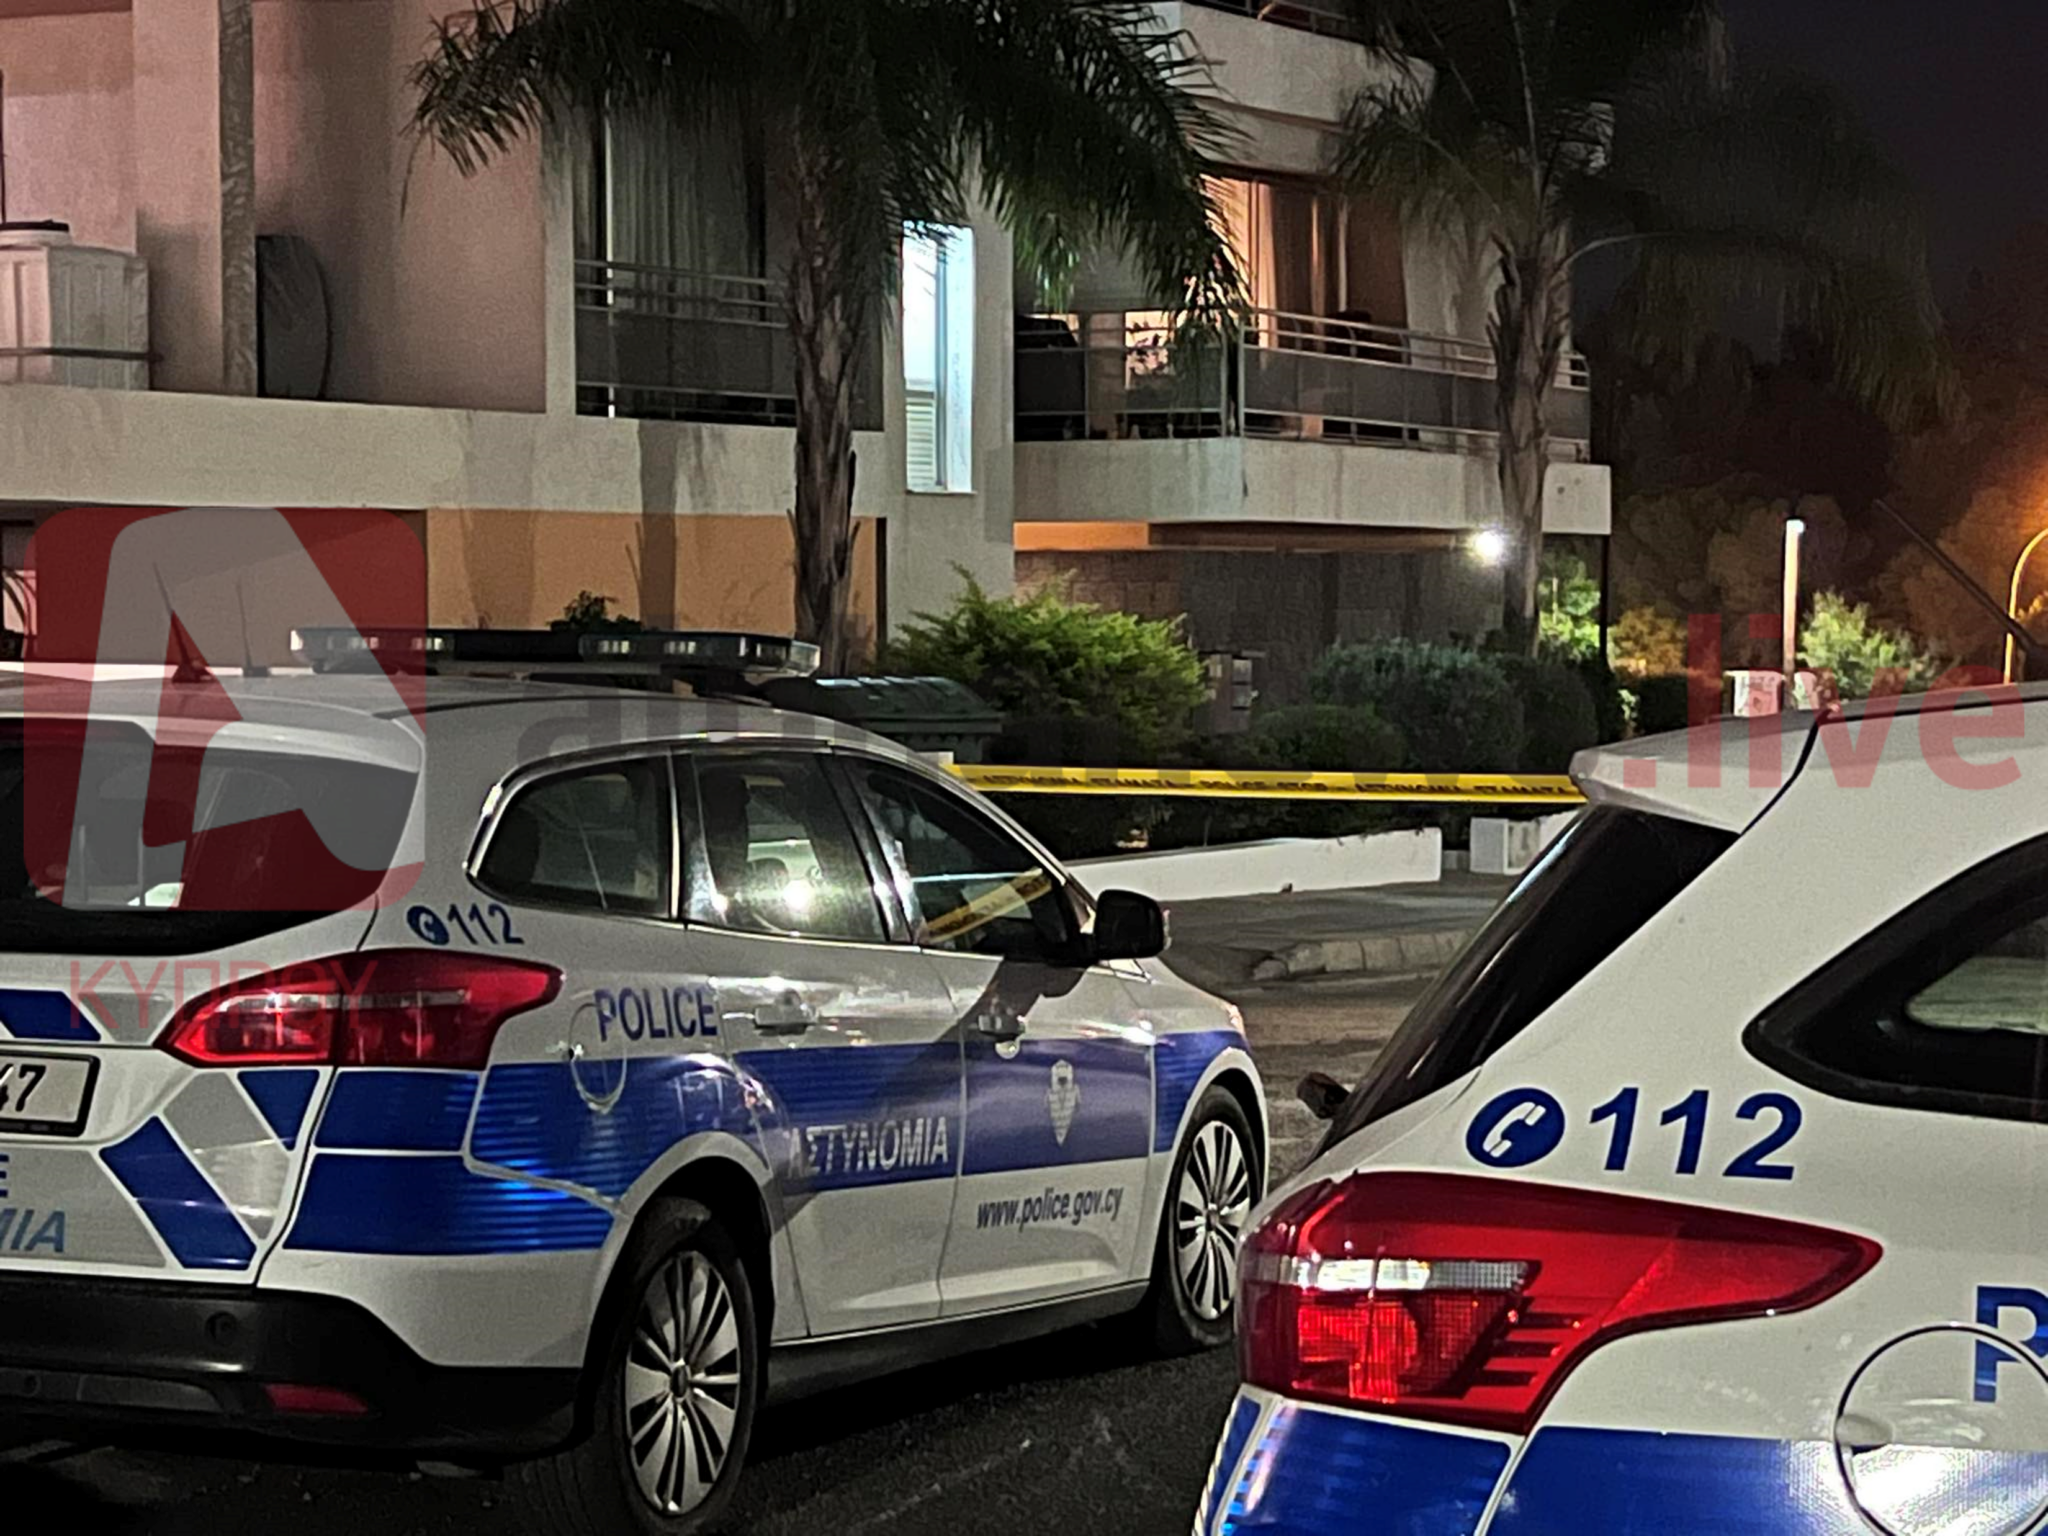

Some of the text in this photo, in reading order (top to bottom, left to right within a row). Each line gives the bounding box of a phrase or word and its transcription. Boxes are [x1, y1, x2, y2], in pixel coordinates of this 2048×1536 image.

[447, 903, 524, 945] 112
[594, 985, 718, 1042] POLICE
[1589, 1087, 1803, 1181] 112
[977, 1187, 1124, 1232] www.police.gov.cy
